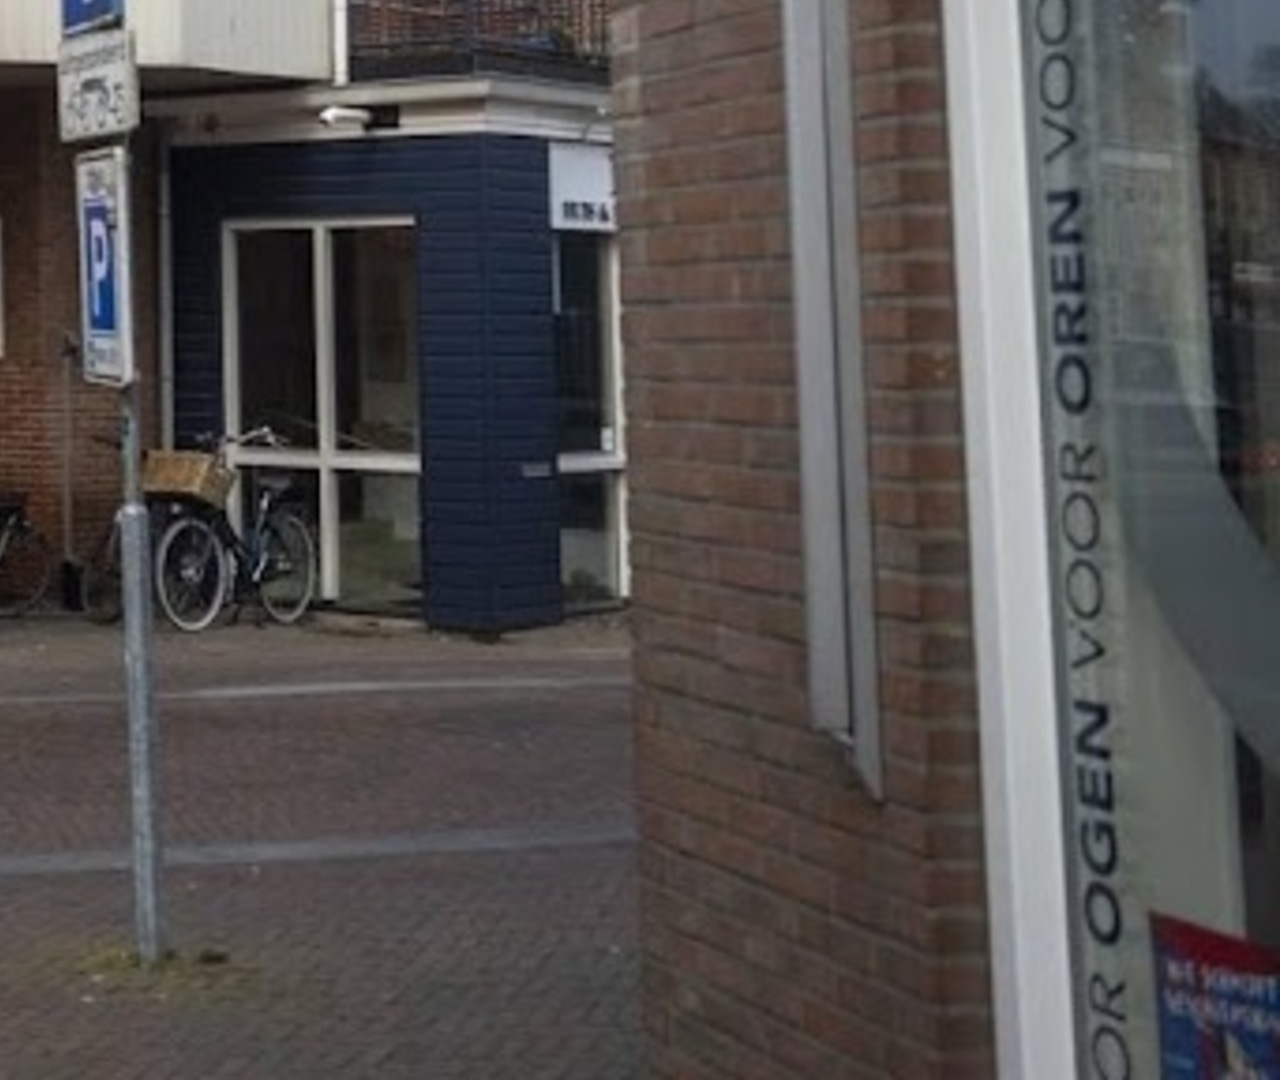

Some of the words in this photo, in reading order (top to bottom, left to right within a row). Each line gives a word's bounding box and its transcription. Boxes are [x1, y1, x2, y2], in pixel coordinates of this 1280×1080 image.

[1045, 189, 1093, 416] OREN
[1058, 441, 1107, 671] VOOR
[1072, 699, 1123, 947] OGEN
